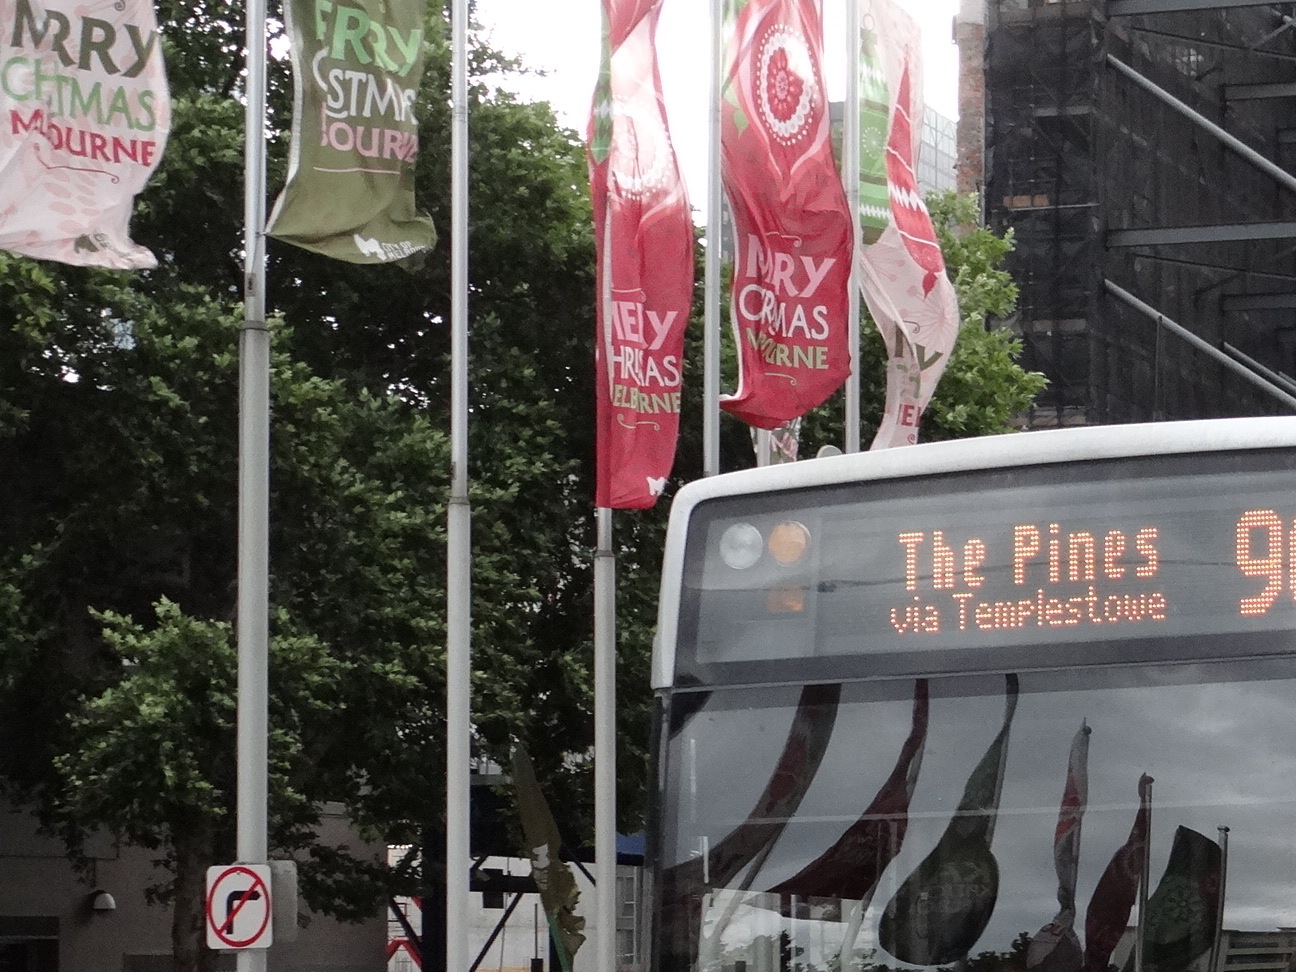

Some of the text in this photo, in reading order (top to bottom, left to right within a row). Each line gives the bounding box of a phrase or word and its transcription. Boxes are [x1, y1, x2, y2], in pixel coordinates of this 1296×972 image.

[899, 531, 985, 590] The
[1014, 523, 1158, 585] Pines
[890, 596, 938, 633] via
